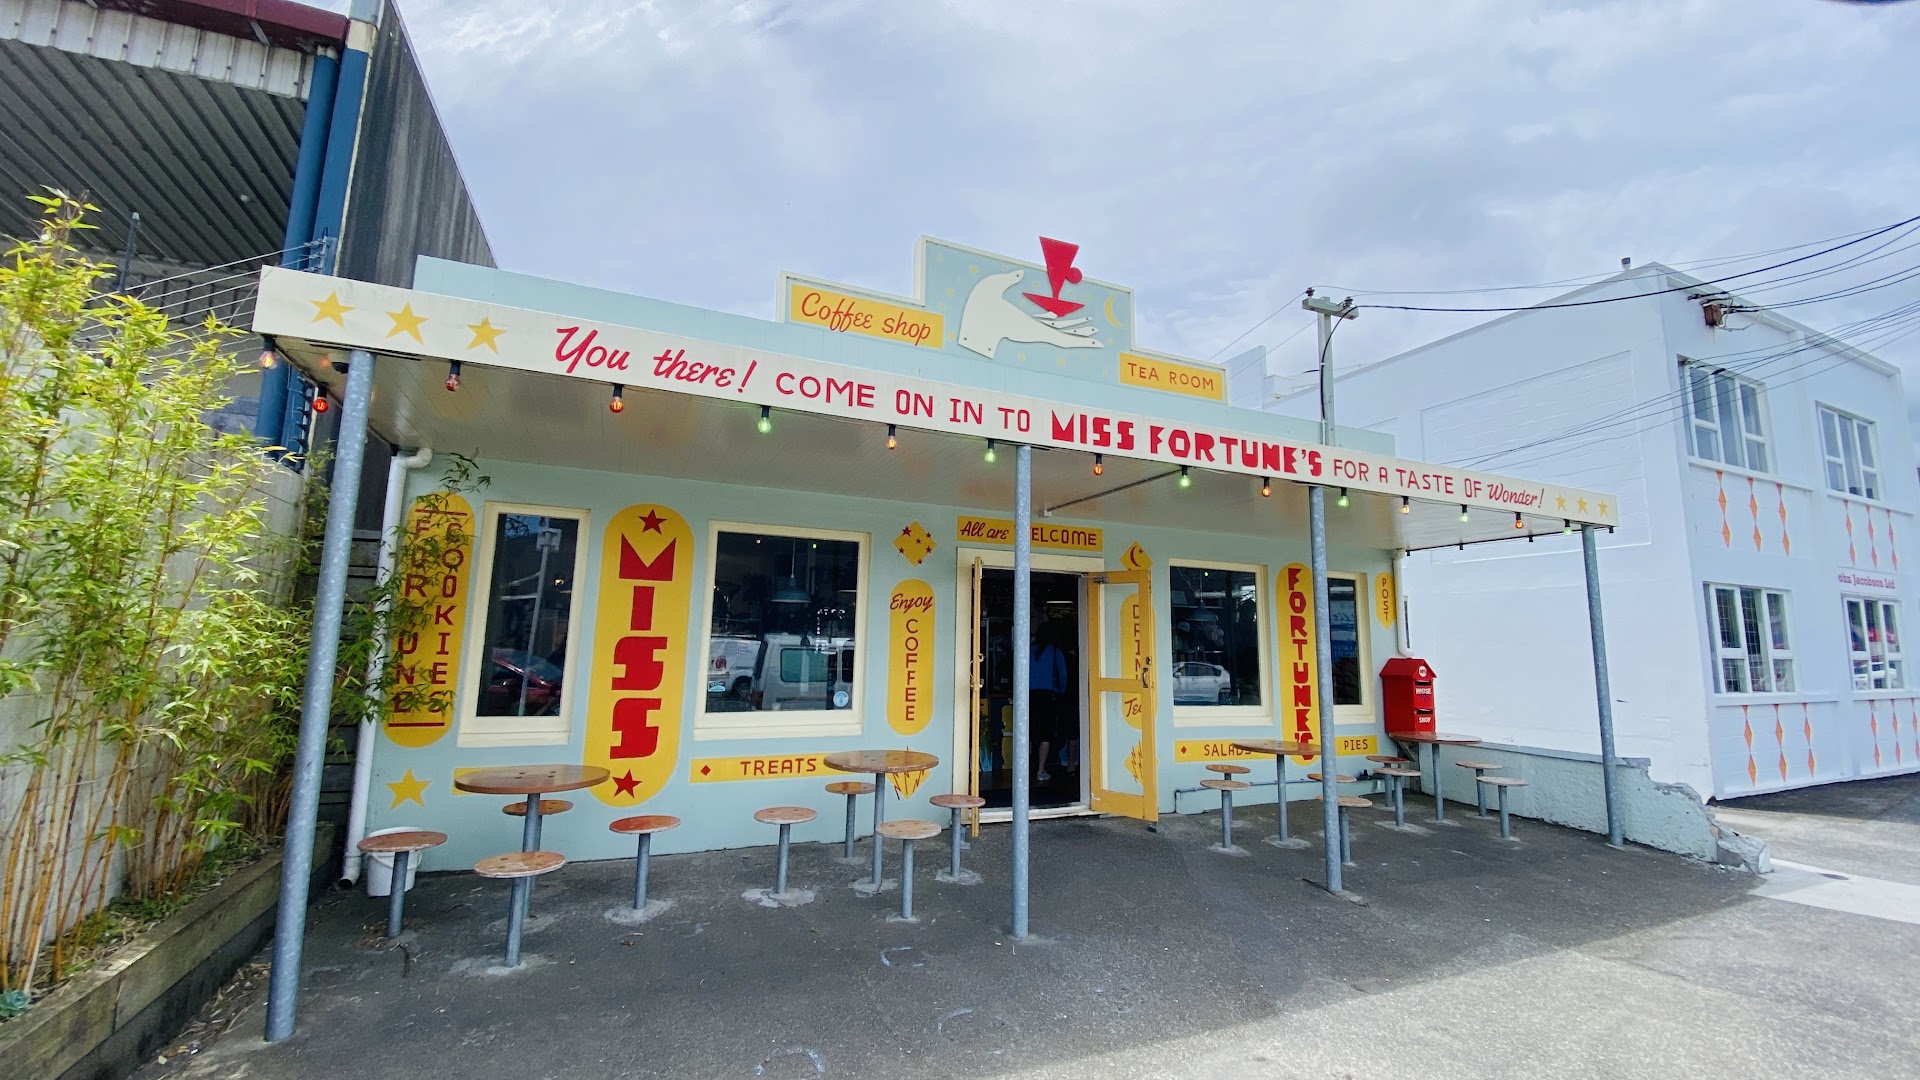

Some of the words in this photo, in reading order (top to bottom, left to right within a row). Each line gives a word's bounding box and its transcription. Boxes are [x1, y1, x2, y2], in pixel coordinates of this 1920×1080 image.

[801, 292, 873, 332] Coffee
[882, 312, 931, 347] shop
[1127, 362, 1160, 382] TEA
[1169, 371, 1214, 391] ROOM
[555, 326, 630, 374] You
[653, 349, 757, 393] there!
[776, 372, 876, 408] COME
[895, 389, 934, 418] ON
[949, 398, 983, 425] IN
[998, 407, 1030, 432] TO
[1051, 409, 1135, 451] MISS
[1149, 425, 1322, 477] FORTUNE'S
[1333, 459, 1369, 482] FOR
[1378, 466, 1388, 483] A
[1395, 468, 1454, 495] TASTE
[1464, 477, 1482, 498] OF
[1487, 482, 1545, 509] Wonder!
[960, 520, 986, 537] All
[986, 528, 1010, 540] are
[1014, 525, 1097, 546] ELCOME
[889, 593, 934, 614] Enjoy
[1381, 578, 1389, 621] POST
[609, 533, 677, 759] MISS
[905, 618, 919, 721] COFFEE
[1415, 687, 1432, 695] HOUSE
[1418, 716, 1431, 724] SHOP
[1344, 738, 1369, 751] PIES
[740, 757, 817, 776] TREATS
